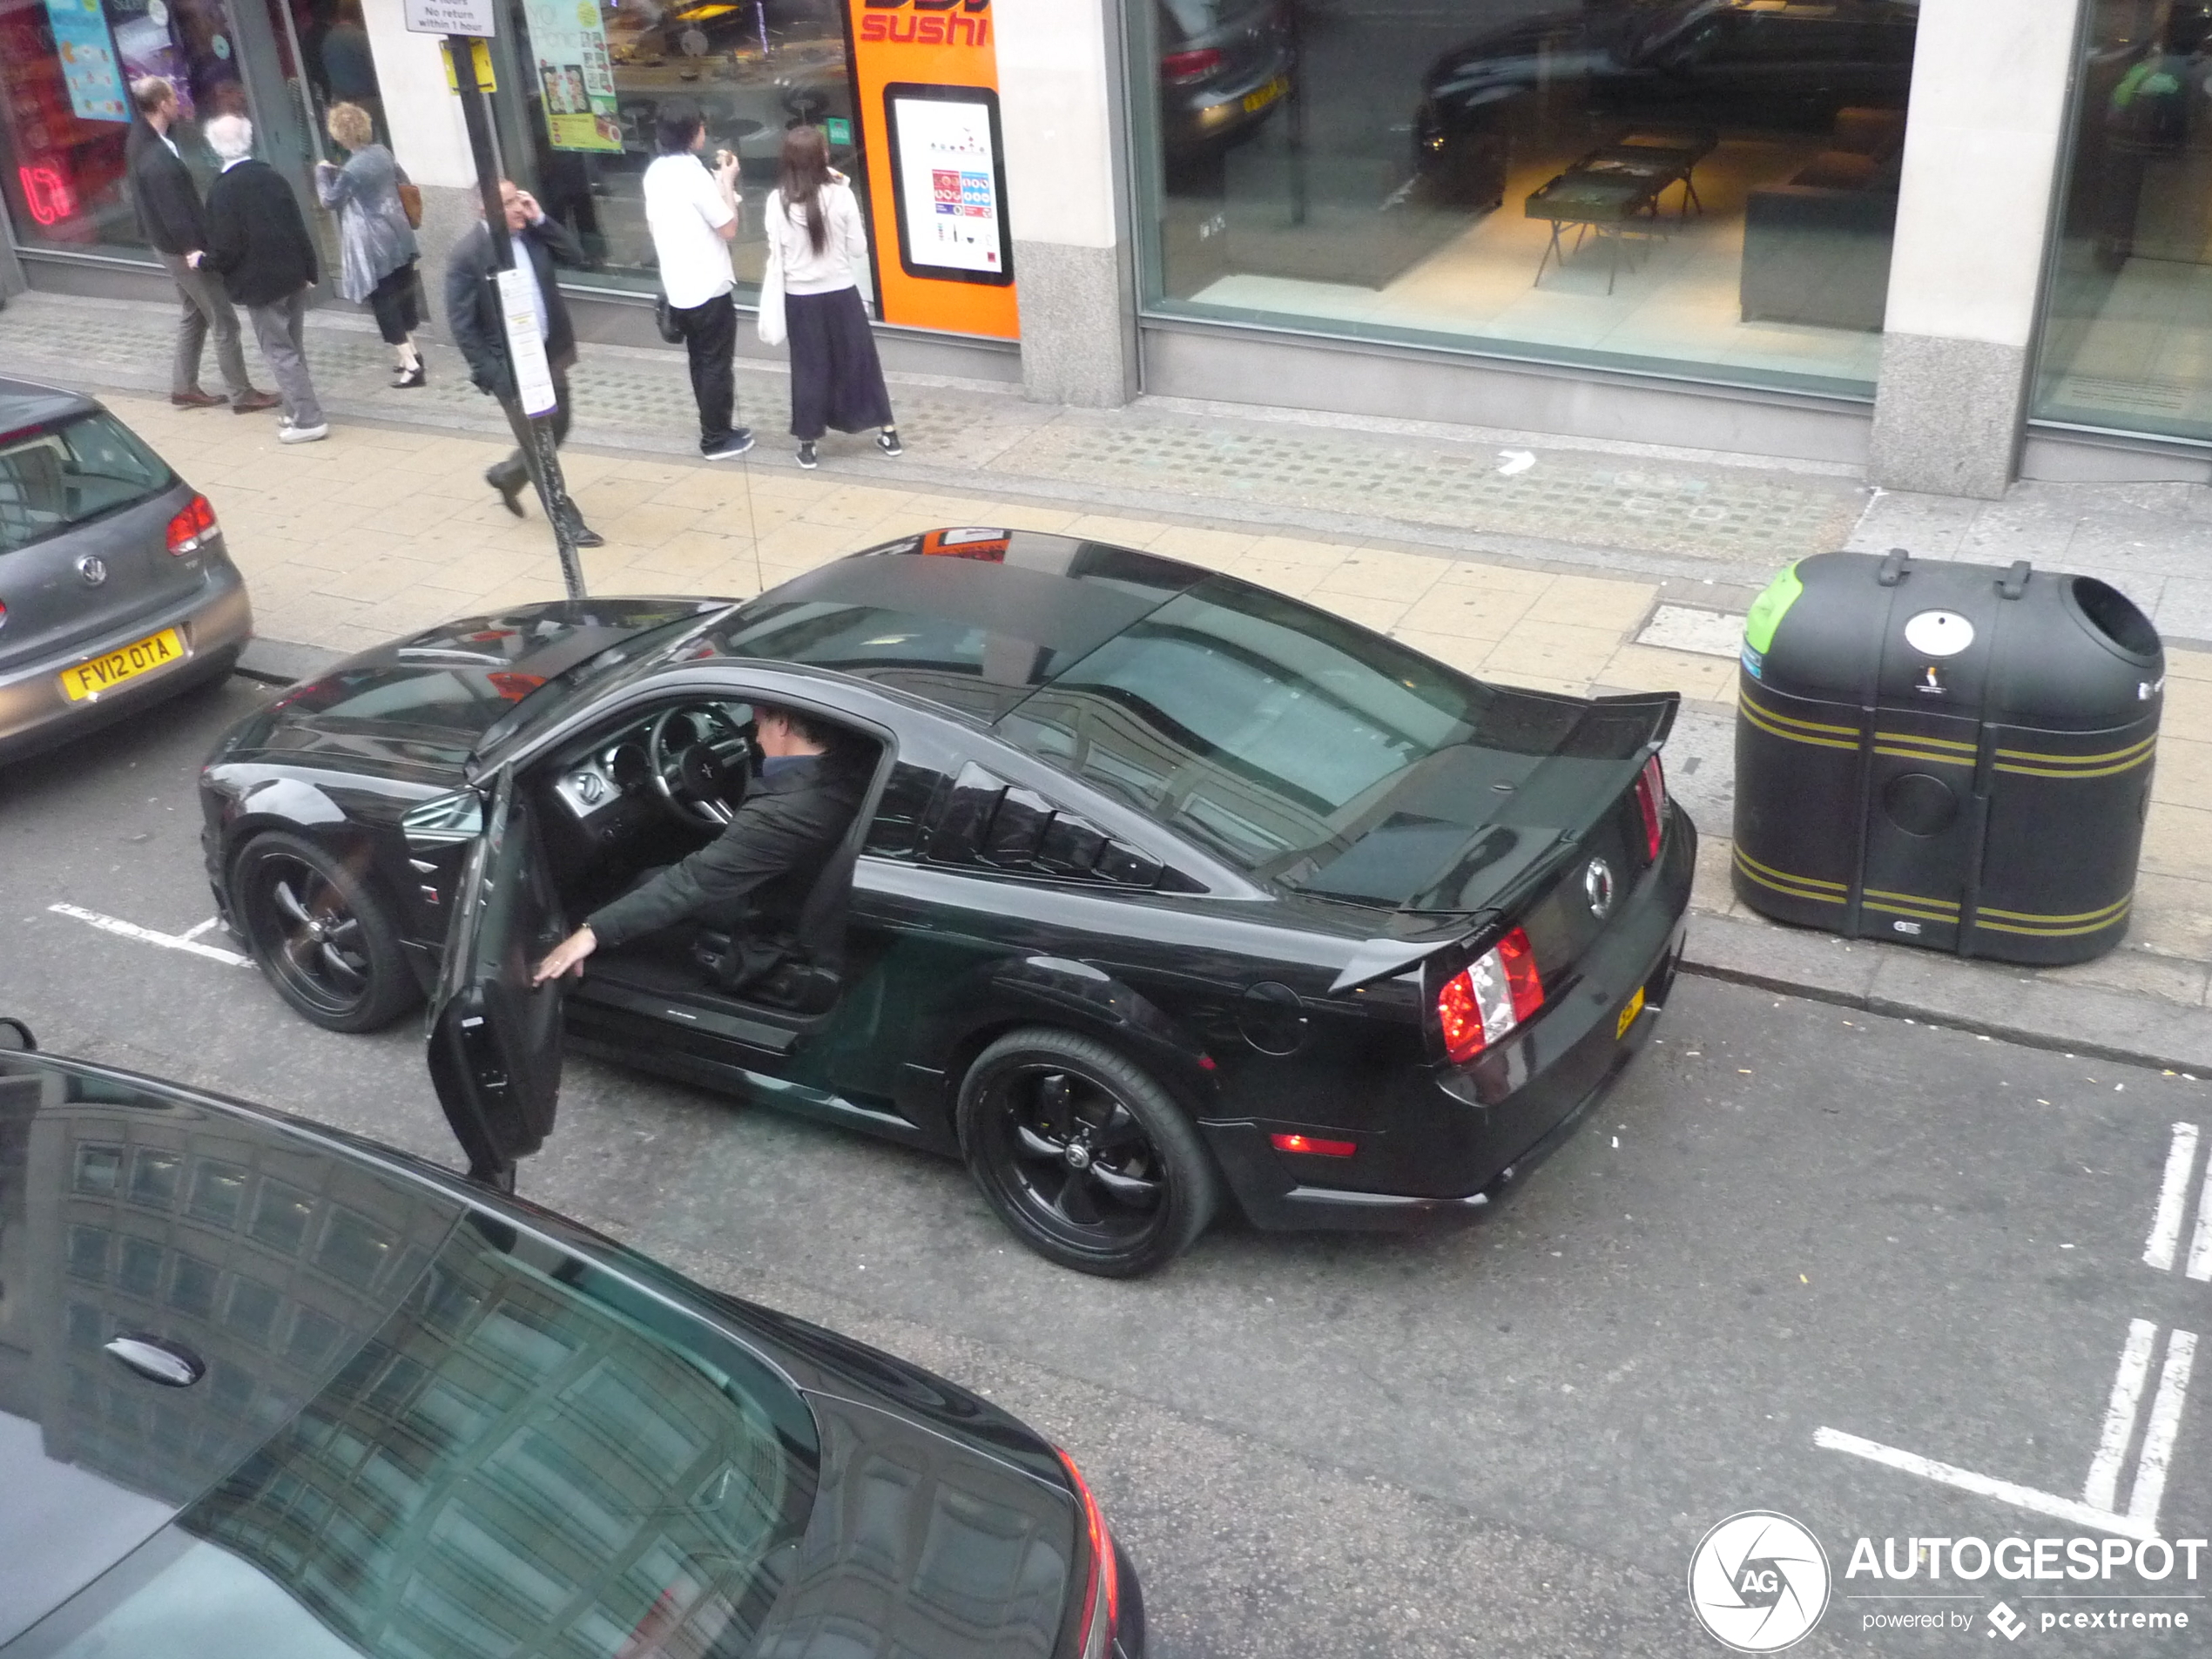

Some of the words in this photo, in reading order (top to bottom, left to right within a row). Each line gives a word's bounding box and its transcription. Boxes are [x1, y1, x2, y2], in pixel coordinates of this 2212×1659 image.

[418, 18, 449, 29] within
[459, 22, 482, 31] hour
[424, 7, 440, 17] No
[442, 9, 475, 19] return
[860, 11, 988, 47] sushi
[78, 654, 130, 691] FV12
[128, 637, 171, 669] OTA
